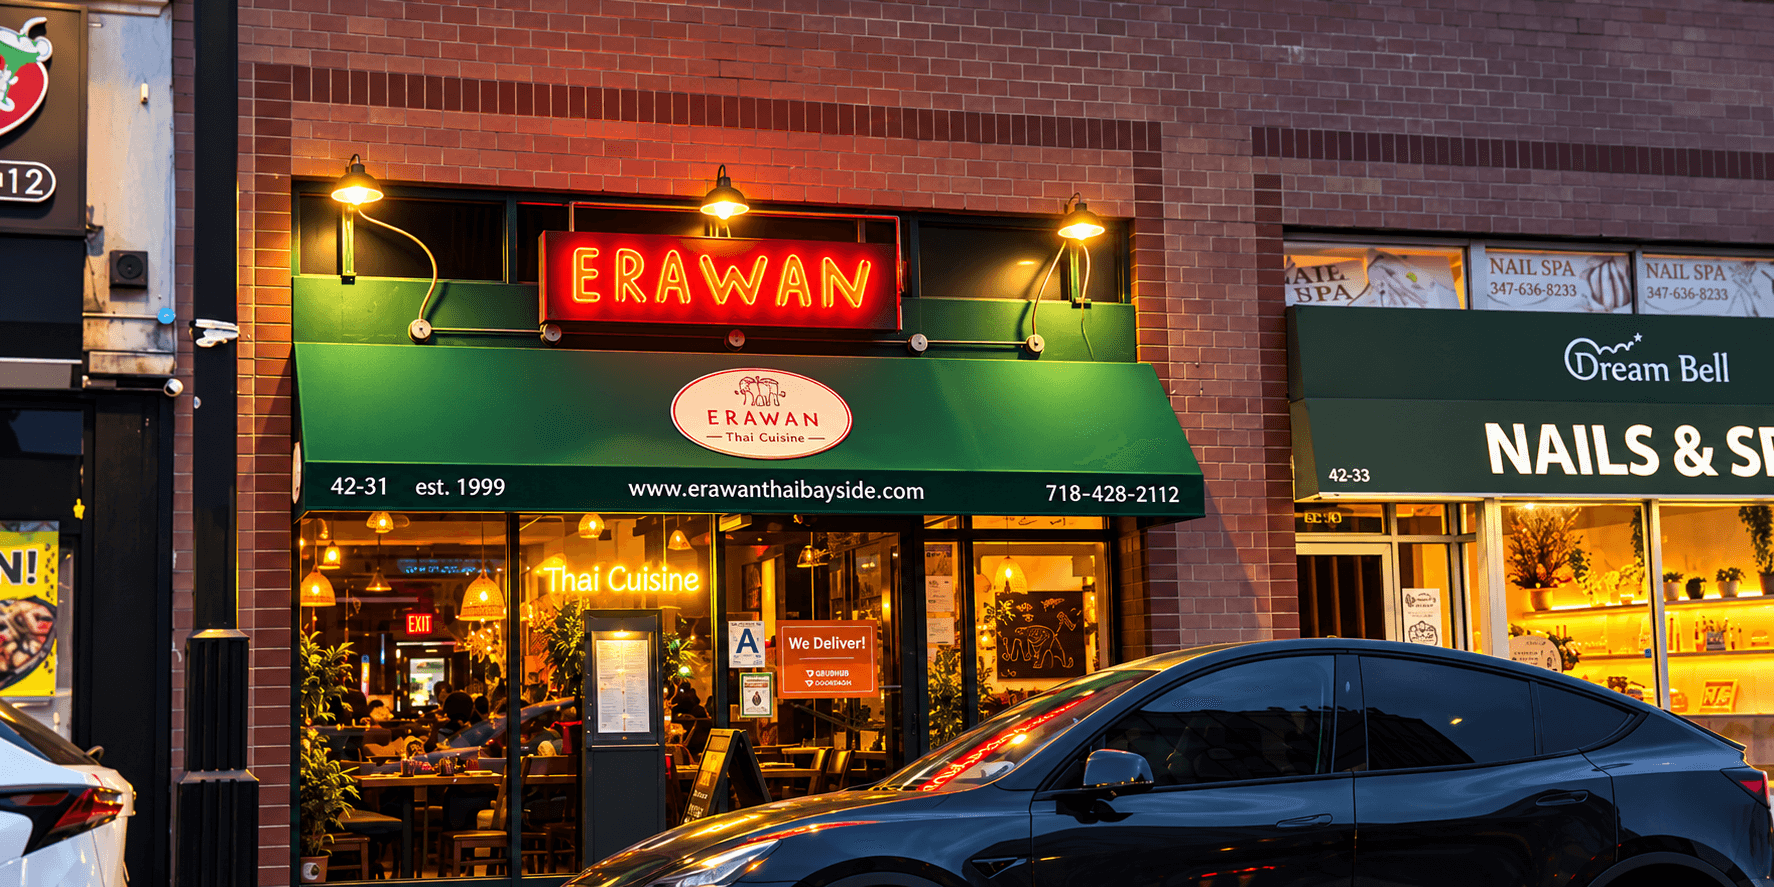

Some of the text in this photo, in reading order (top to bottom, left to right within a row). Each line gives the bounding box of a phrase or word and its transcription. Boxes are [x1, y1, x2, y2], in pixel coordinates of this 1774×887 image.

[1489, 257, 1577, 277] NAIL SPA
[1645, 262, 1727, 281] NAIL SPA
[572, 247, 871, 308] ERAWAN
[1489, 281, 1578, 297] 347-636-8233
[1645, 285, 1729, 301] 347-636-8233
[1564, 339, 1730, 383] Dream Bell
[707, 409, 819, 427] ERAWAN
[725, 431, 805, 443] Thai Cuisine
[1484, 422, 1660, 477] NAILS
[1673, 424, 1720, 478] &
[1327, 467, 1371, 484] 42-33
[330, 476, 506, 496] 42-31 est. 1999
[628, 479, 925, 503] www.erawanthaibayside.com
[1045, 484, 1180, 503] 718-428-2112
[543, 564, 700, 593] Thai Cuisine
[408, 615, 432, 633] EXIT
[735, 627, 760, 654] A
[788, 635, 866, 650] We Deliver!
